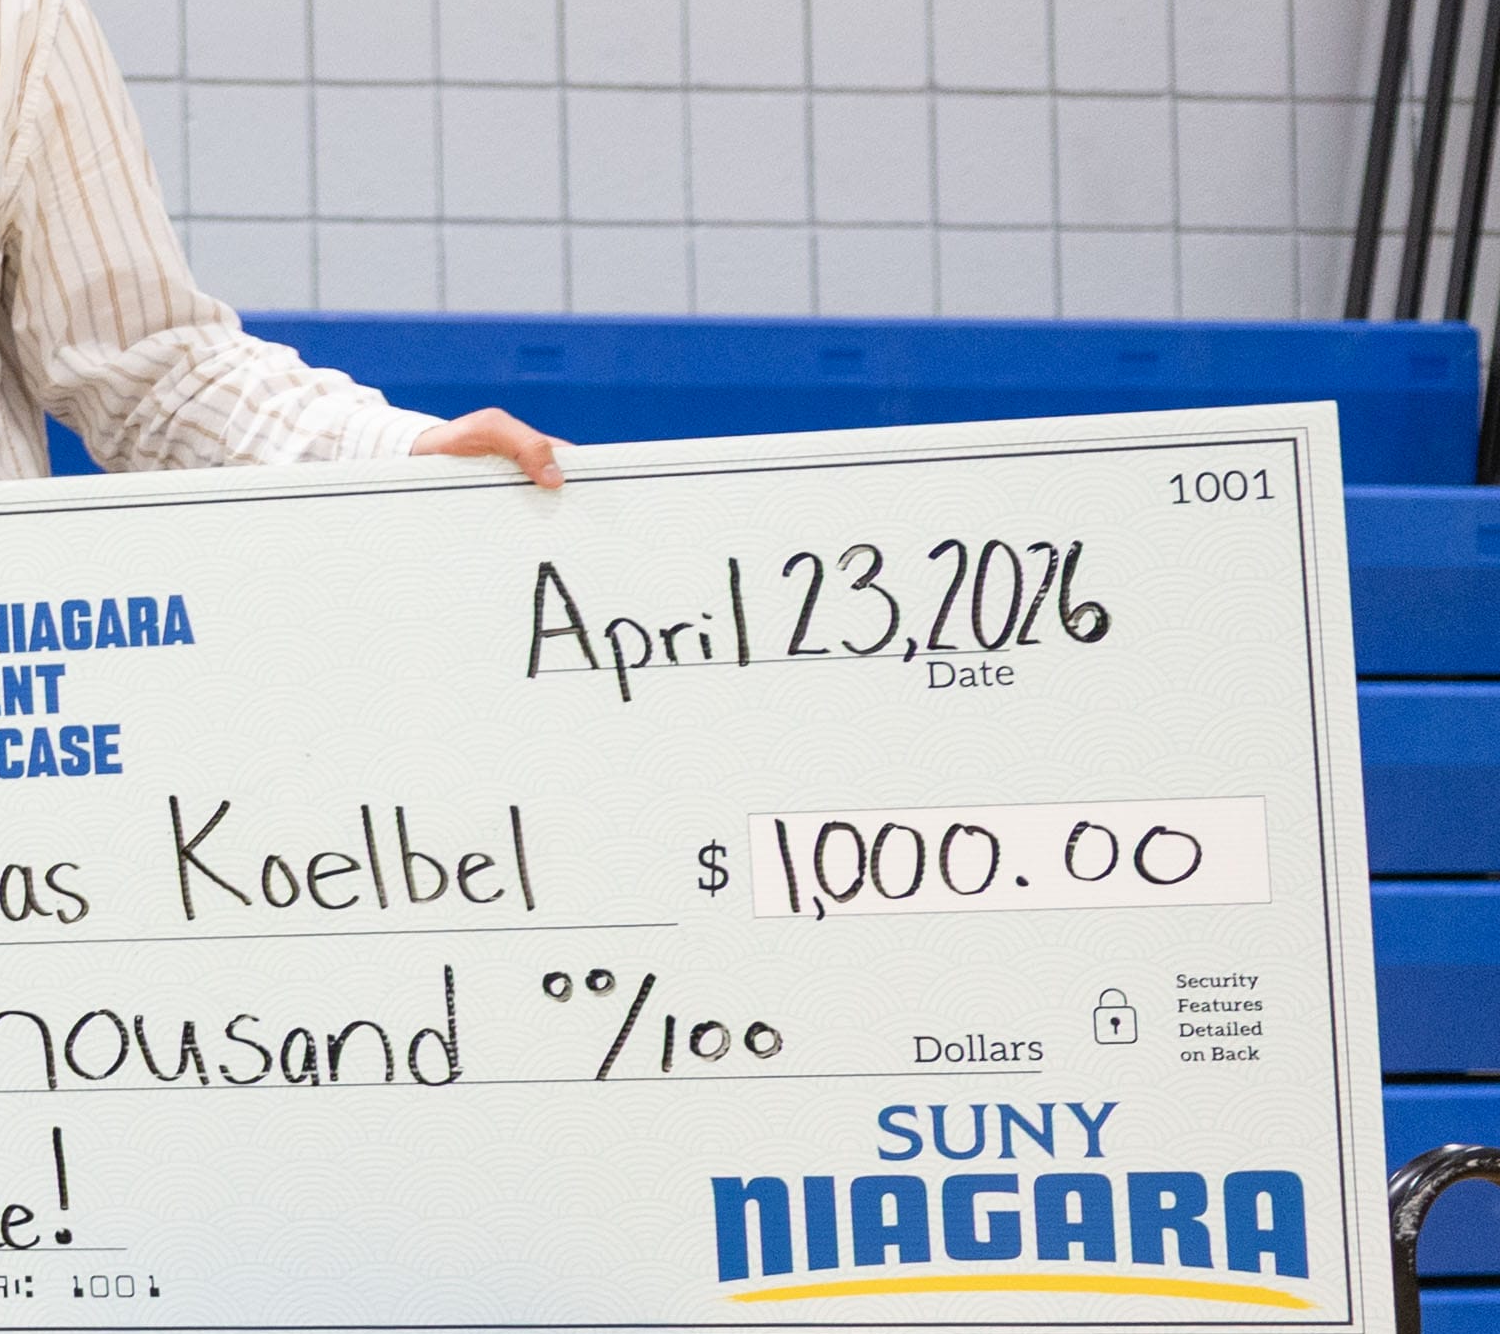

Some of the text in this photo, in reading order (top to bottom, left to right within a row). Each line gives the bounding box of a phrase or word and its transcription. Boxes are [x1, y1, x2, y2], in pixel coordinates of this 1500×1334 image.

[1168, 469, 1275, 506] 1001
[528, 558, 749, 701] April
[928, 660, 1015, 690] Date
[168, 794, 536, 919] Koelbel
[774, 818, 1202, 921] 1,000.00
[1176, 973, 1258, 992] Security
[1177, 997, 1263, 1014] Features
[1179, 1021, 1263, 1038] Detailed
[913, 1035, 1044, 1065] Dollars
[1180, 1045, 1260, 1062] on Back
[877, 1101, 1120, 1163] SUNY
[711, 1170, 1310, 1284] NIAGARA
